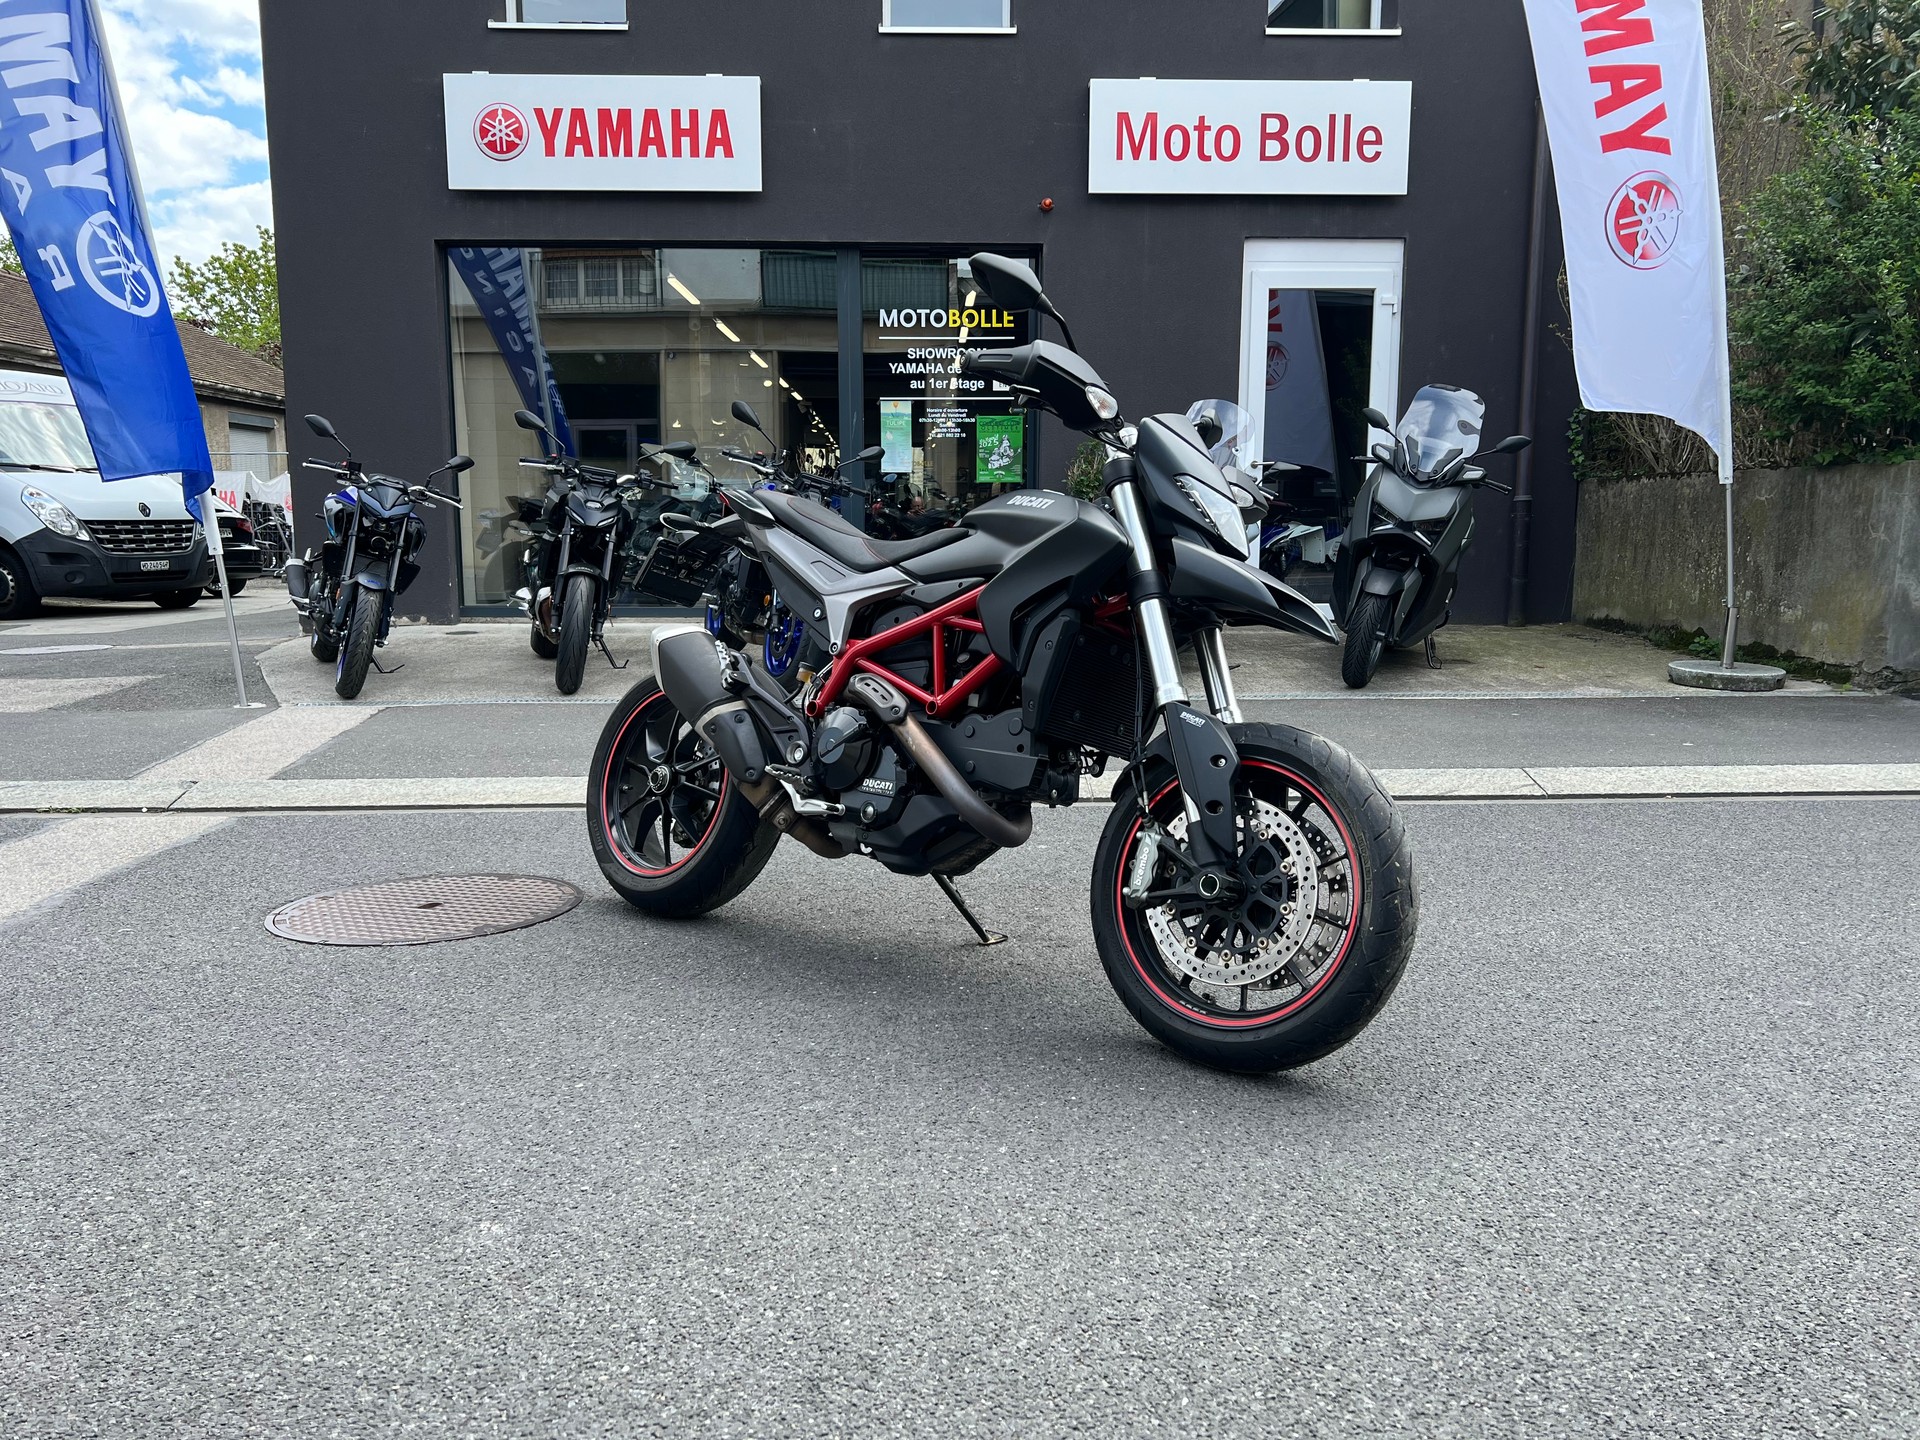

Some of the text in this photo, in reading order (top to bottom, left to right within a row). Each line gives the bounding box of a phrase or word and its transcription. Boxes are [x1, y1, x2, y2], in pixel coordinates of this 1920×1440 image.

[532, 107, 735, 159] YAMAHA
[1115, 111, 1384, 164] Moto Bolle
[879, 309, 1015, 328] MOTOBOLLE
[907, 348, 987, 359] SHOWR
[889, 363, 962, 374] YAMAHA de
[910, 381, 925, 389] au
[929, 378, 948, 389] 1er
[1006, 495, 1056, 509] DUCATI
[862, 778, 894, 791] DUCATI
[1133, 846, 1149, 886] brembo
